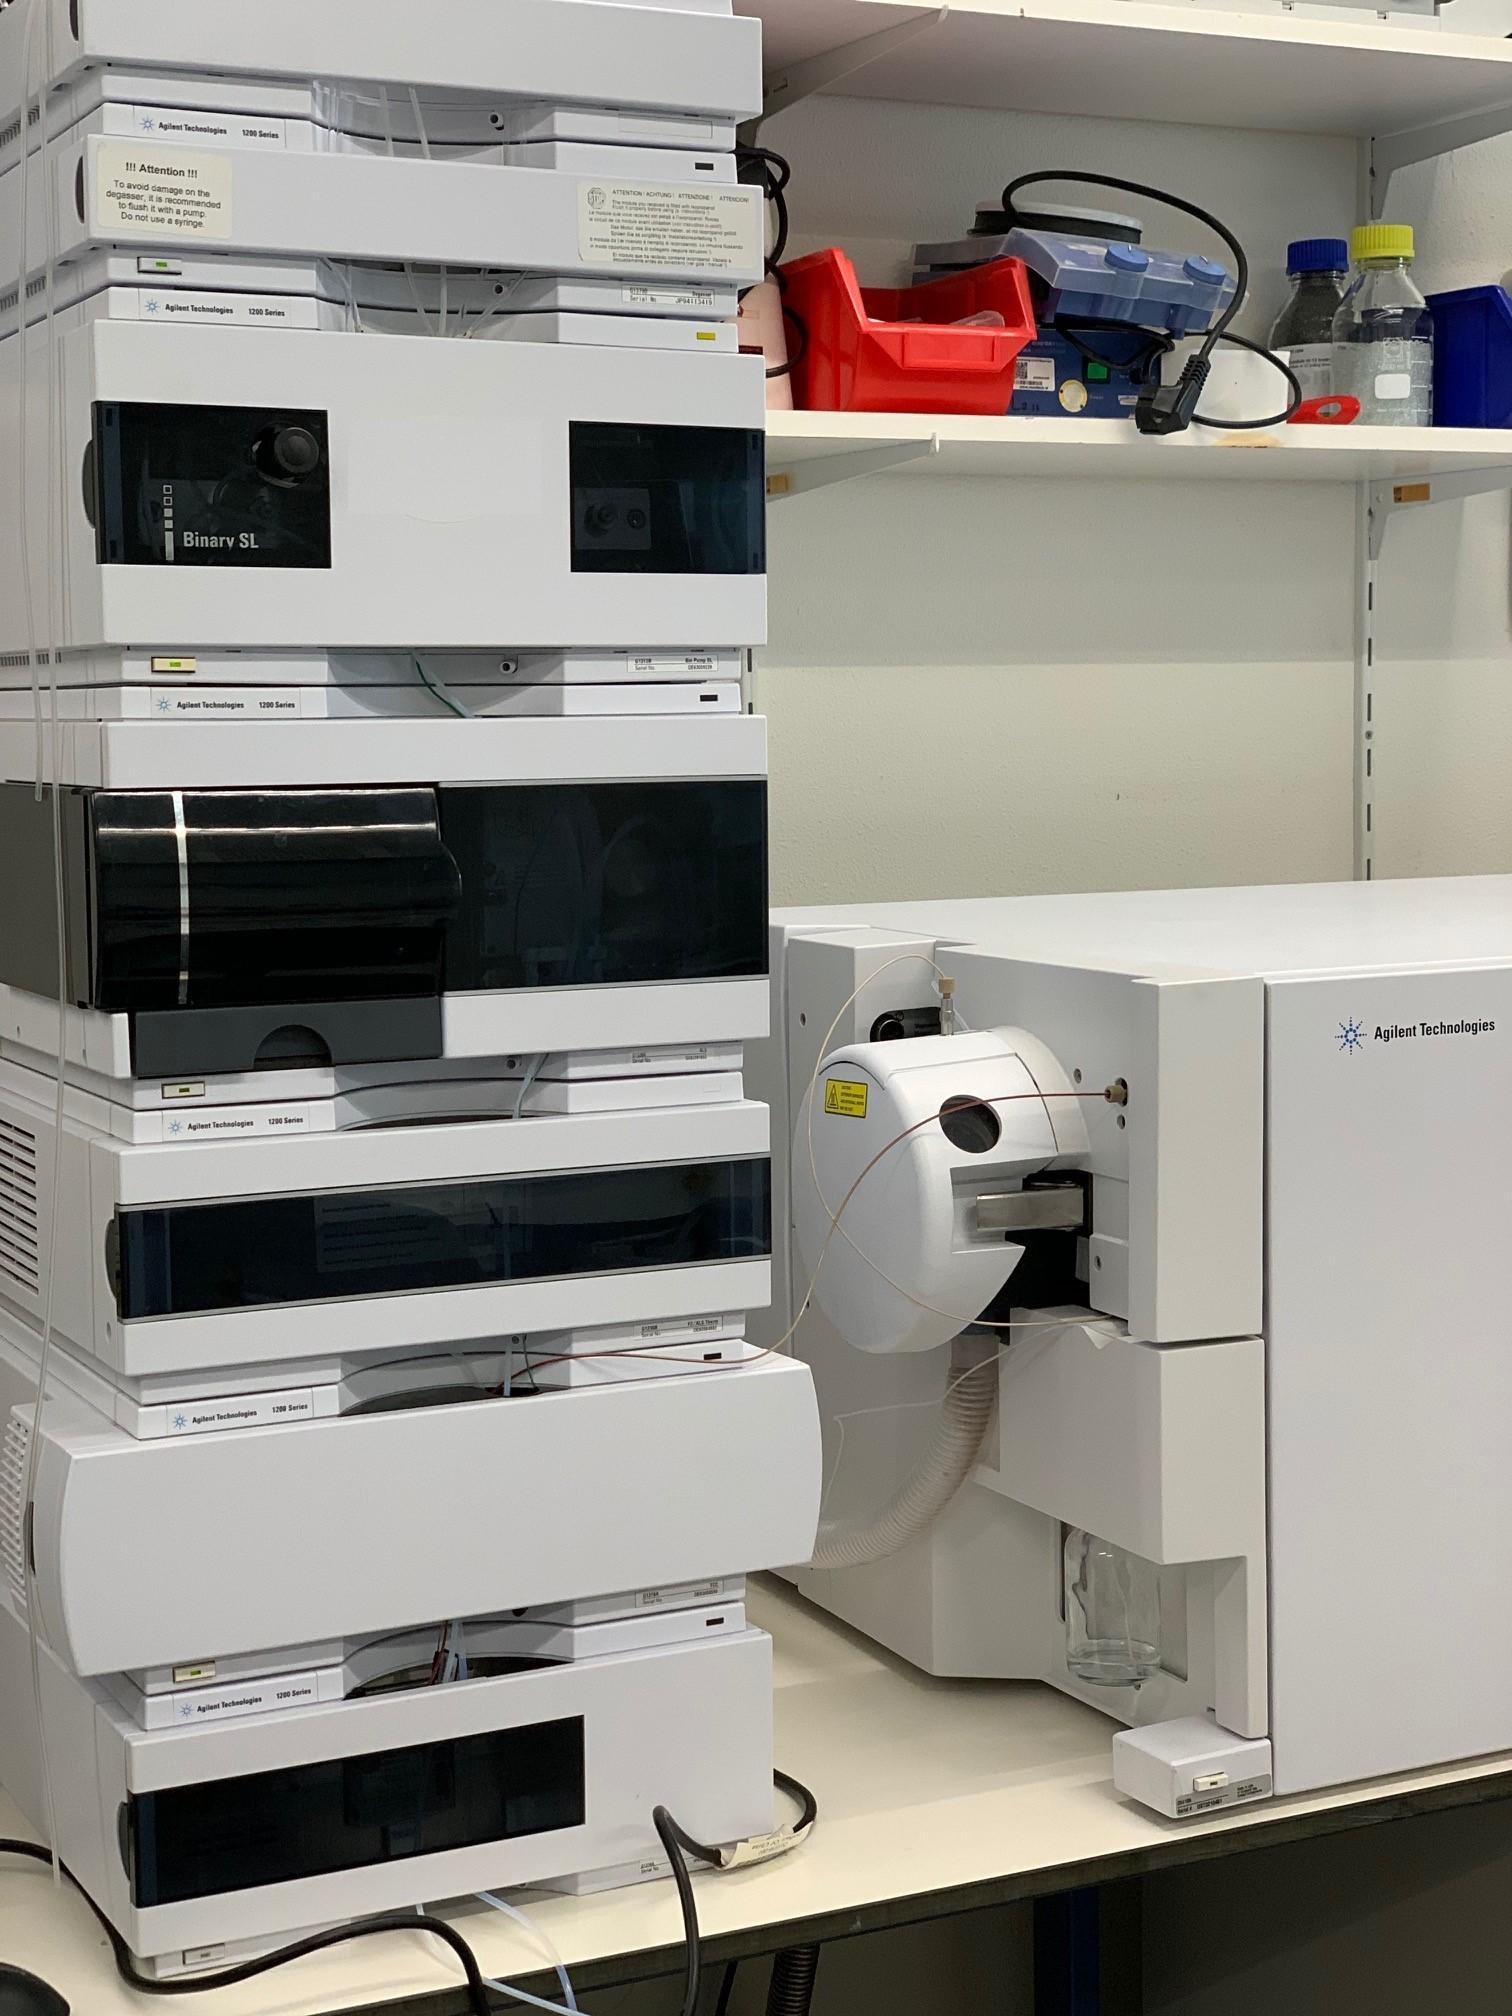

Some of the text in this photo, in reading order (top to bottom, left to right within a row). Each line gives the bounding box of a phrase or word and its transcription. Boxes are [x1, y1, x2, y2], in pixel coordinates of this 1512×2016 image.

[158, 120, 279, 139] Agilent Technologies 1200 Series
[125, 162, 198, 178] !!! Attention !!!
[114, 180, 210, 198] To avoid damage on the
[106, 190, 146, 202] degasser,
[149, 194, 154, 202] it
[164, 196, 221, 209] recommended
[128, 202, 148, 212] flush
[150, 204, 156, 212] it
[157, 206, 174, 214] with
[121, 212, 133, 220] Do
[135, 214, 148, 222] not
[150, 216, 165, 224] use
[165, 303, 286, 318] Agilent Technologies 1200 Series
[183, 531, 260, 551] Binary SL
[176, 700, 296, 711] Agilent Technologies 1200 Series
[1374, 1018, 1496, 1043] Agilent Technologies
[188, 1116, 304, 1132] Agilent Technologies 1200 Series
[192, 1403, 308, 1425] Agilent Technologies 1200 Series
[197, 1688, 312, 1713] Agilent Technologies 1200 Series
